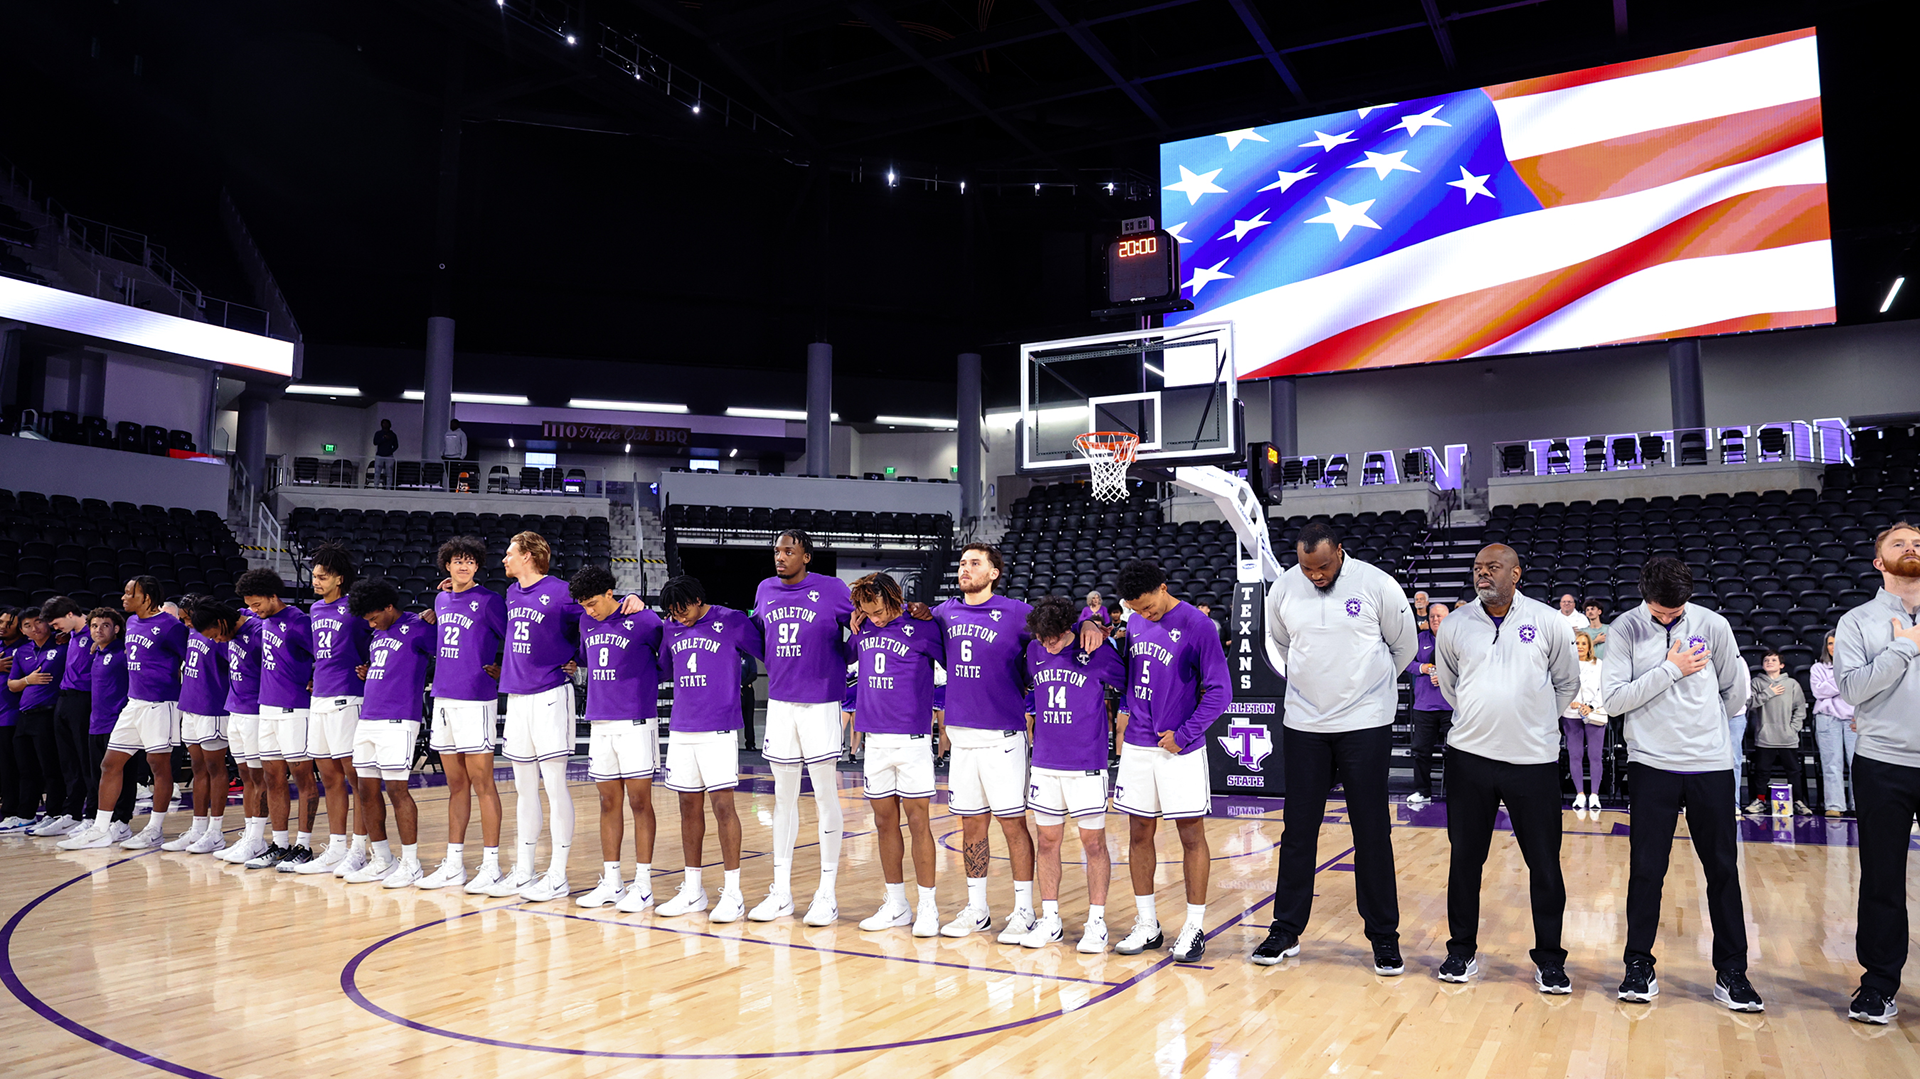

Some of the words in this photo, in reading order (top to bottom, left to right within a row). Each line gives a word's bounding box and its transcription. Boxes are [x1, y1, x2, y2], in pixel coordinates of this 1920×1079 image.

[1119, 237, 1156, 257] 20:00
[579, 425, 621, 443] Triple
[624, 427, 651, 441] Oak
[654, 429, 688, 445] BBQ
[438, 613, 474, 630] TARLETON
[507, 607, 545, 624] TARLETON
[765, 606, 817, 624] TARLETON
[311, 618, 343, 632] TARLETON
[513, 621, 530, 641] 25
[778, 622, 800, 644] 97
[947, 623, 998, 644] TARLETON
[318, 631, 332, 648] 24
[444, 626, 460, 646] 22
[585, 633, 630, 650] TARLETON
[1239, 587, 1252, 689] TEXANS
[130, 645, 137, 660] 2
[512, 642, 531, 654] STATE
[671, 637, 721, 655] TARLETON
[776, 644, 802, 657] STATE
[859, 636, 910, 657] TARLETON
[960, 640, 972, 662] 6
[1129, 641, 1174, 667] TARLETON
[188, 650, 199, 667] 13
[371, 649, 389, 667] 30
[599, 647, 609, 667] 8
[686, 652, 697, 673] 4
[874, 652, 886, 674] 0
[592, 669, 616, 681] STATE
[680, 674, 707, 687] STATE
[955, 664, 981, 679] STATE
[1034, 668, 1087, 688] TARLETON
[1140, 660, 1151, 684] 5
[868, 675, 894, 690] STATE
[1047, 685, 1067, 709] 14
[1134, 685, 1153, 701] STAT
[1043, 711, 1072, 724] STATE
[1227, 775, 1265, 787] STATE
